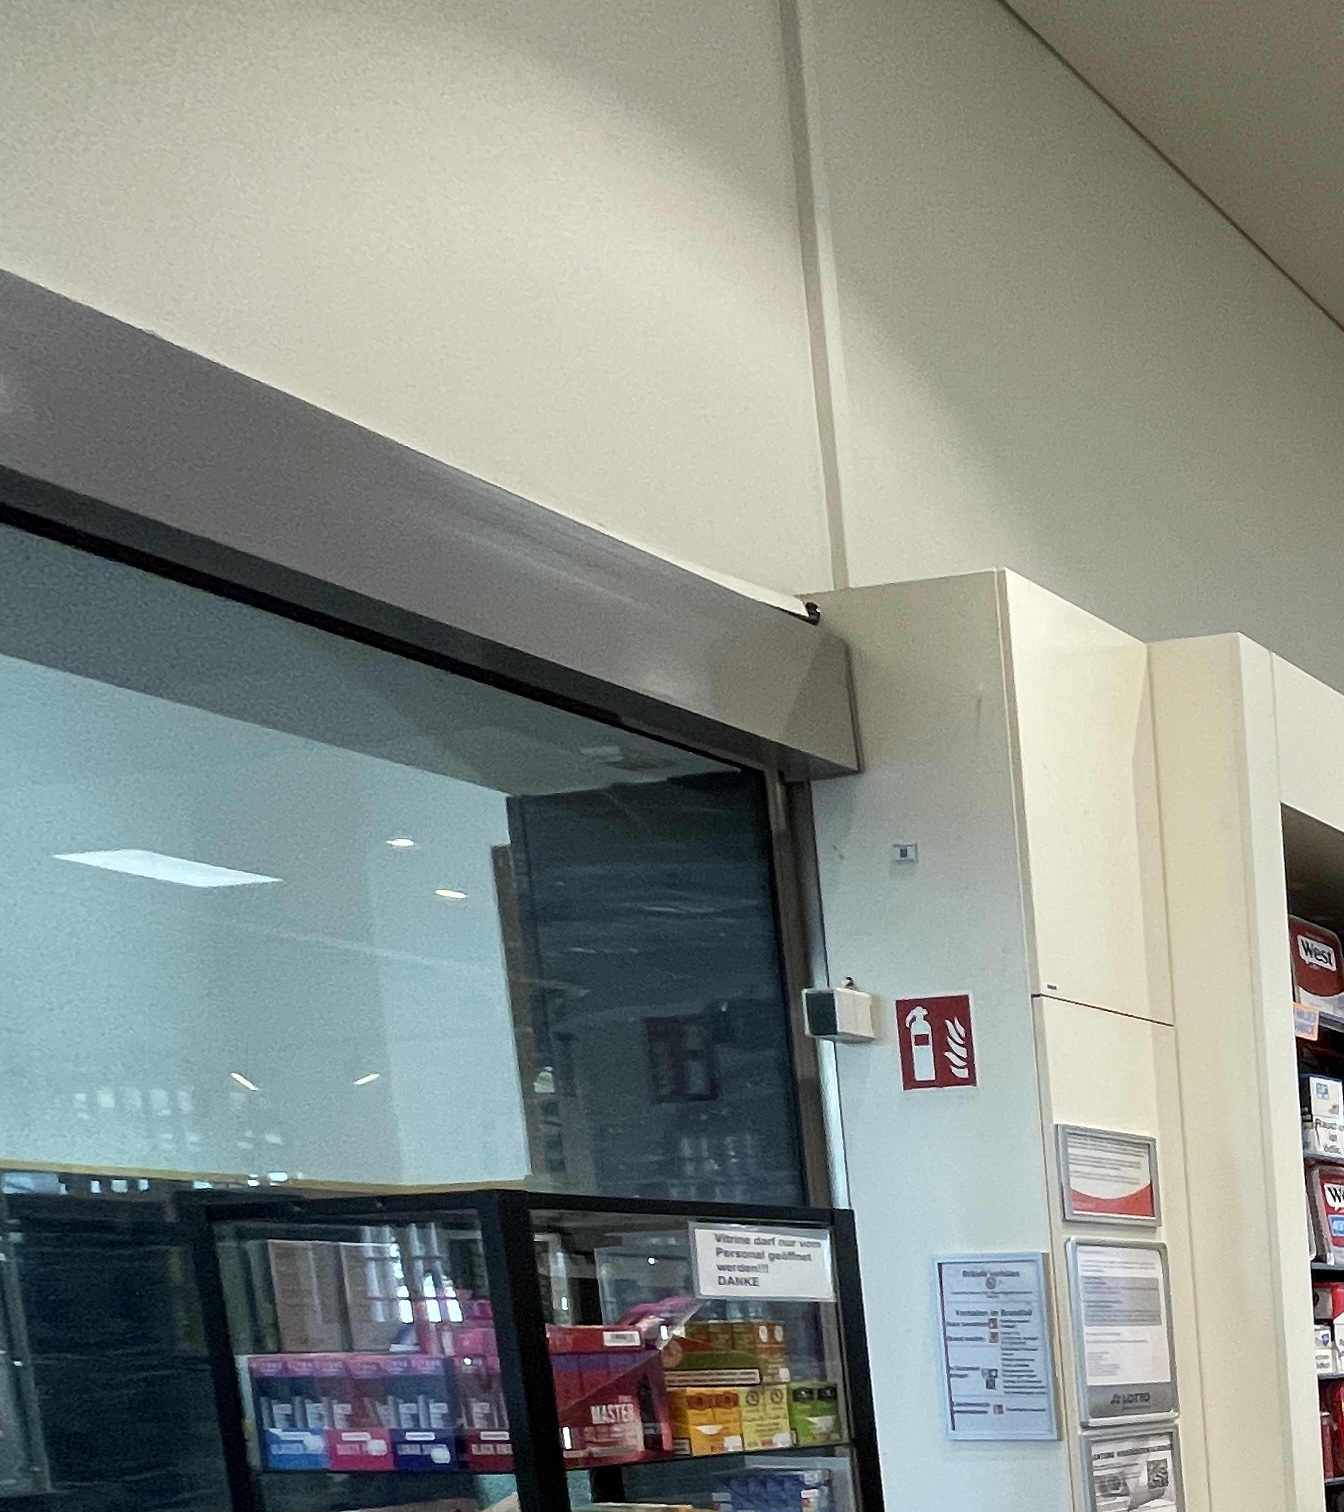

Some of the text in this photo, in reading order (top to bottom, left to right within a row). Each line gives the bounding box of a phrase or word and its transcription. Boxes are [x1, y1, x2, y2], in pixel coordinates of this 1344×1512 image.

[1301, 940, 1333, 967] West
[714, 1233, 821, 1248] Vitrine darf nur vom
[715, 1247, 812, 1262] Personal geöffnet
[718, 1275, 759, 1287] DANKE
